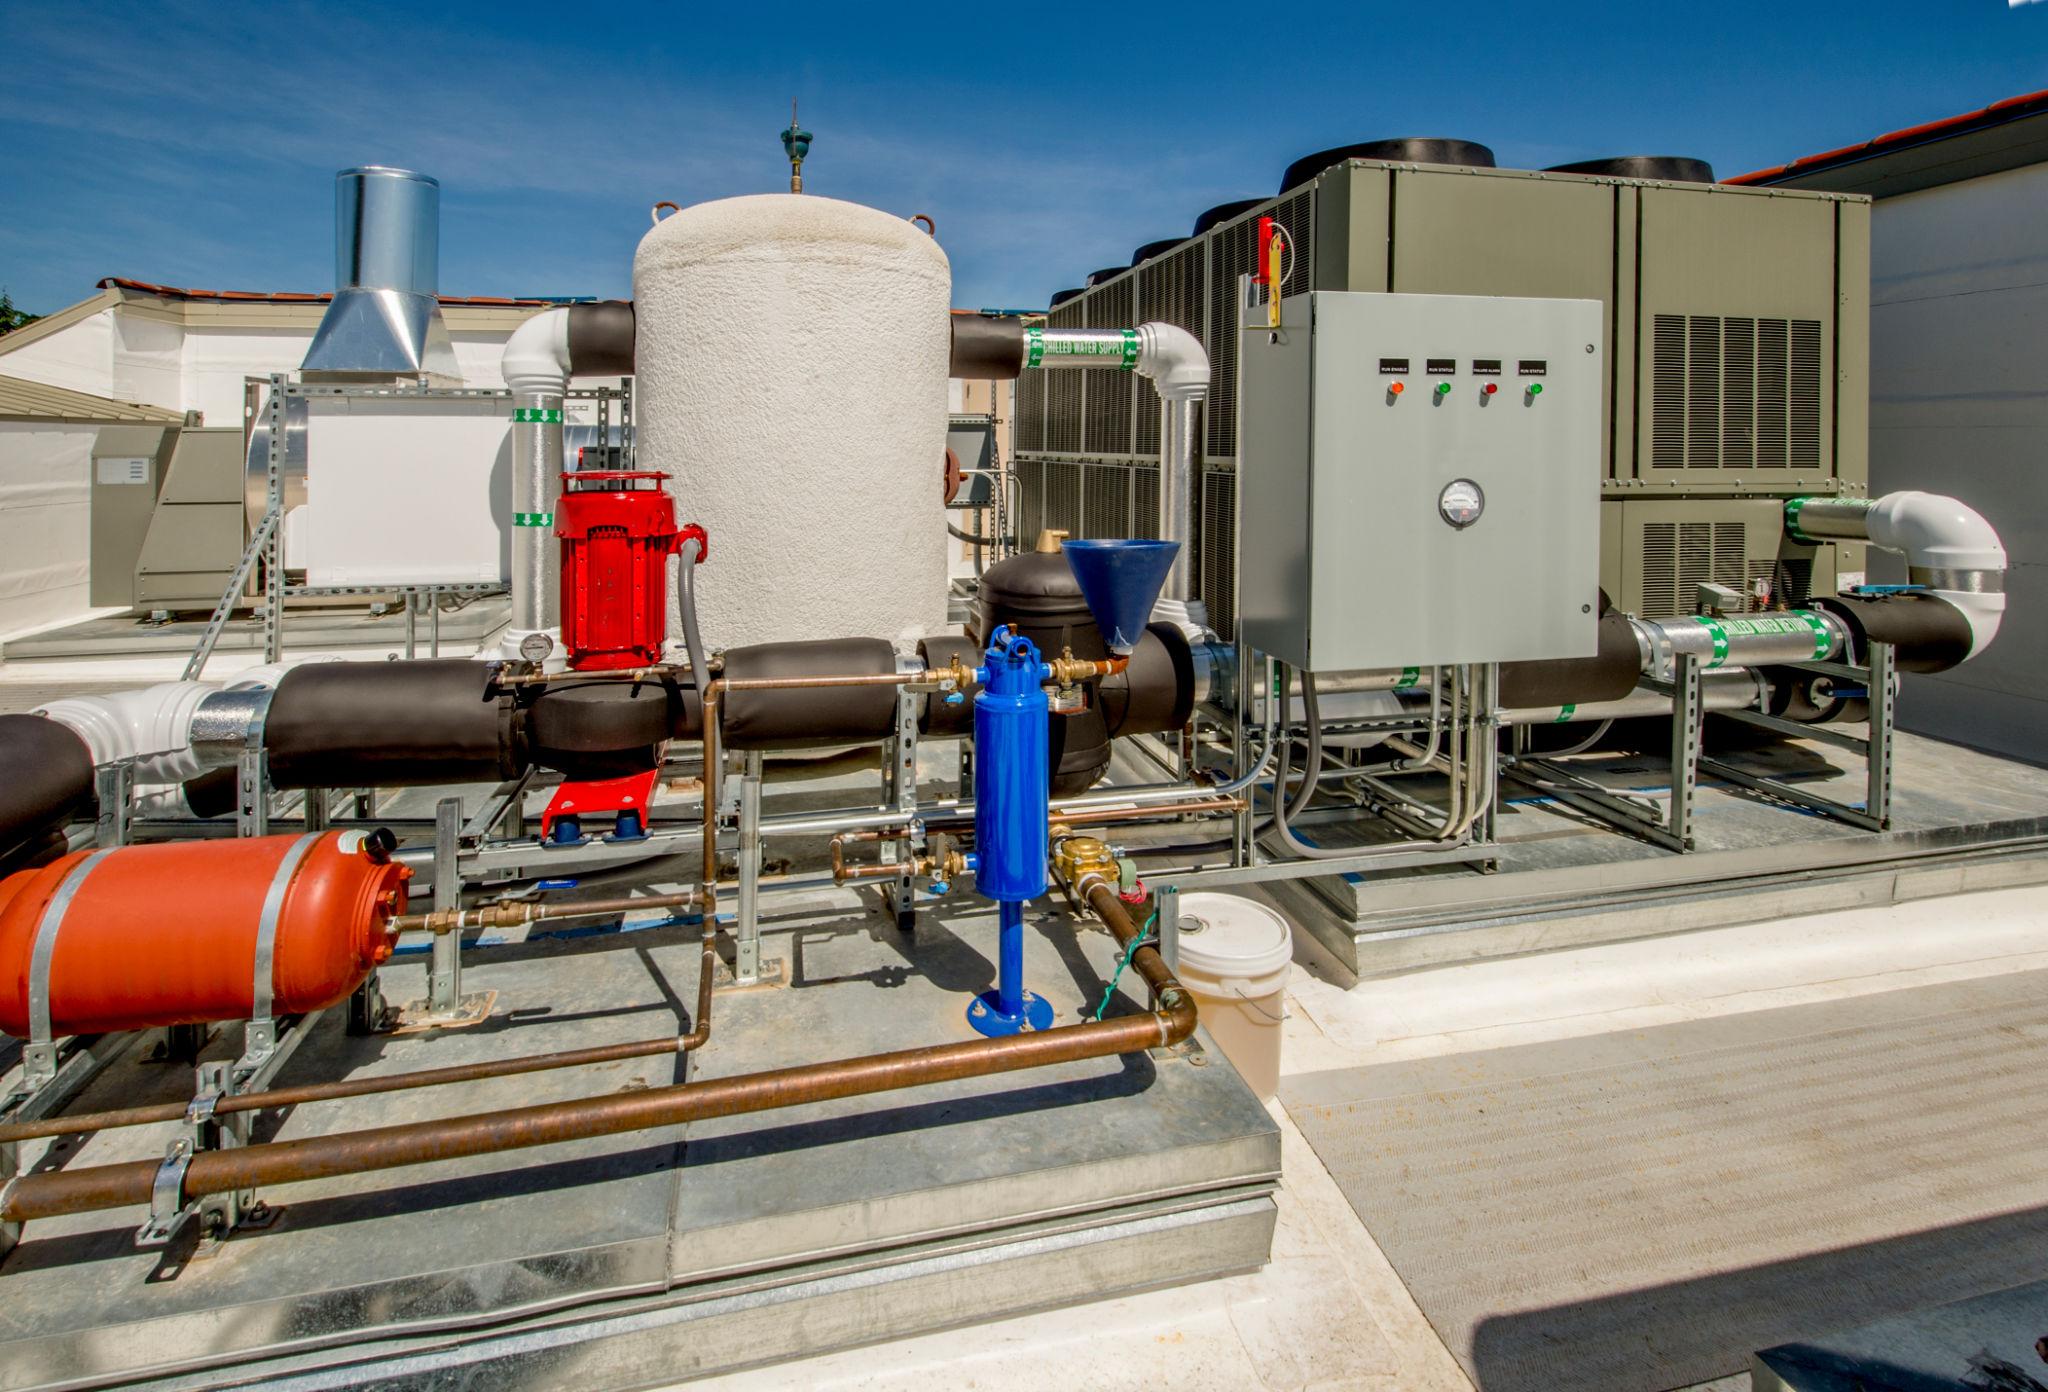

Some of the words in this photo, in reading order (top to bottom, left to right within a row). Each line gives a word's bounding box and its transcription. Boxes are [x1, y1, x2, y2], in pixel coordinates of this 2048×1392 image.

[1043, 340, 1072, 354] CHILLED
[1074, 340, 1097, 354] WATER
[1099, 340, 1124, 354] SUPPLY
[1718, 620, 1755, 635] CHILLED
[1748, 619, 1782, 634] WATER
